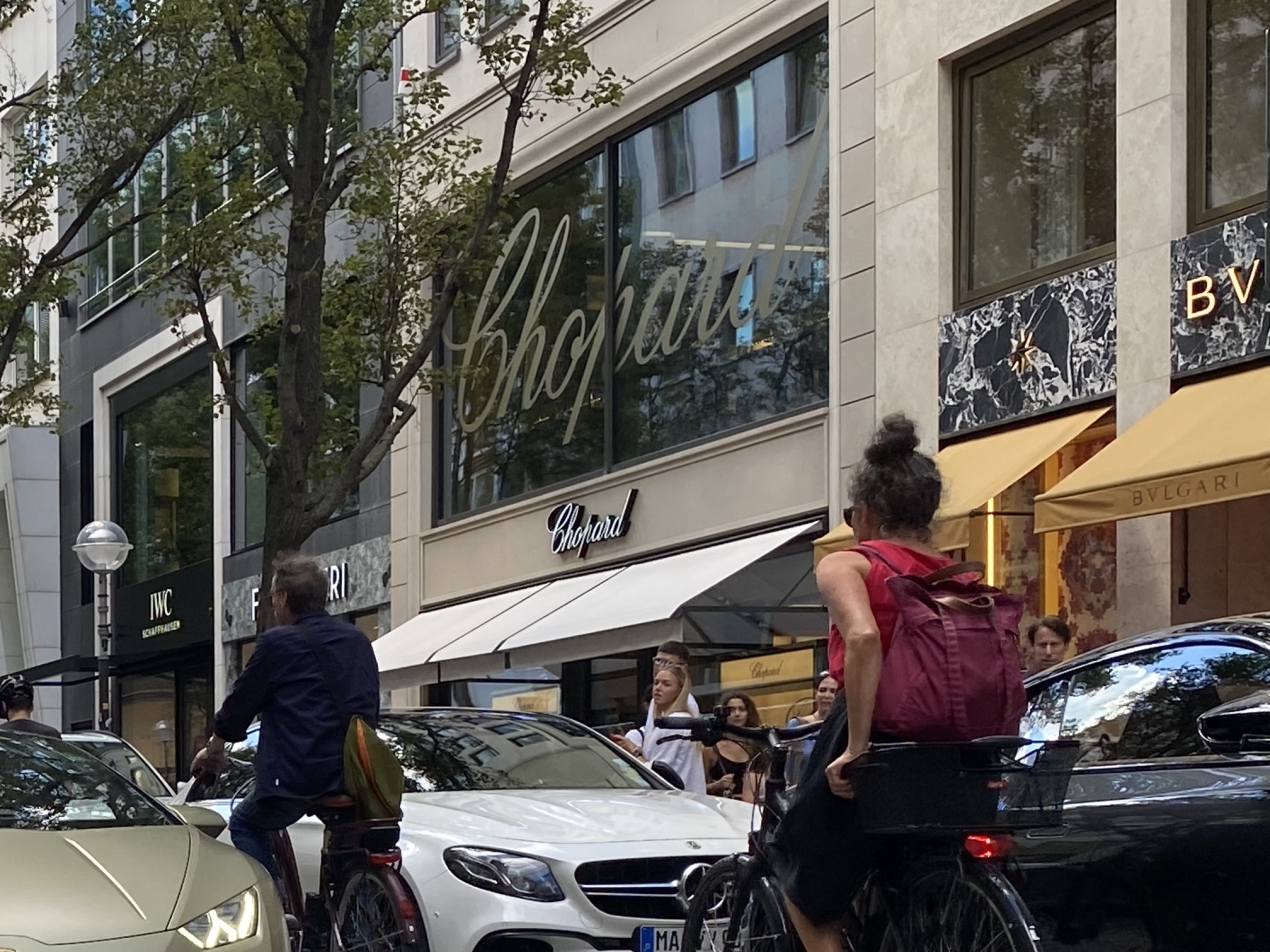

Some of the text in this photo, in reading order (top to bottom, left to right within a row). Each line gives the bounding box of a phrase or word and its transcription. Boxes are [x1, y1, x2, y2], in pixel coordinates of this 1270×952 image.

[441, 88, 829, 446] Chopard
[1132, 472, 1240, 507] BVLGARI
[546, 488, 639, 559] Chopard
[150, 588, 173, 621] IWC
[749, 659, 783, 680] Chopard
